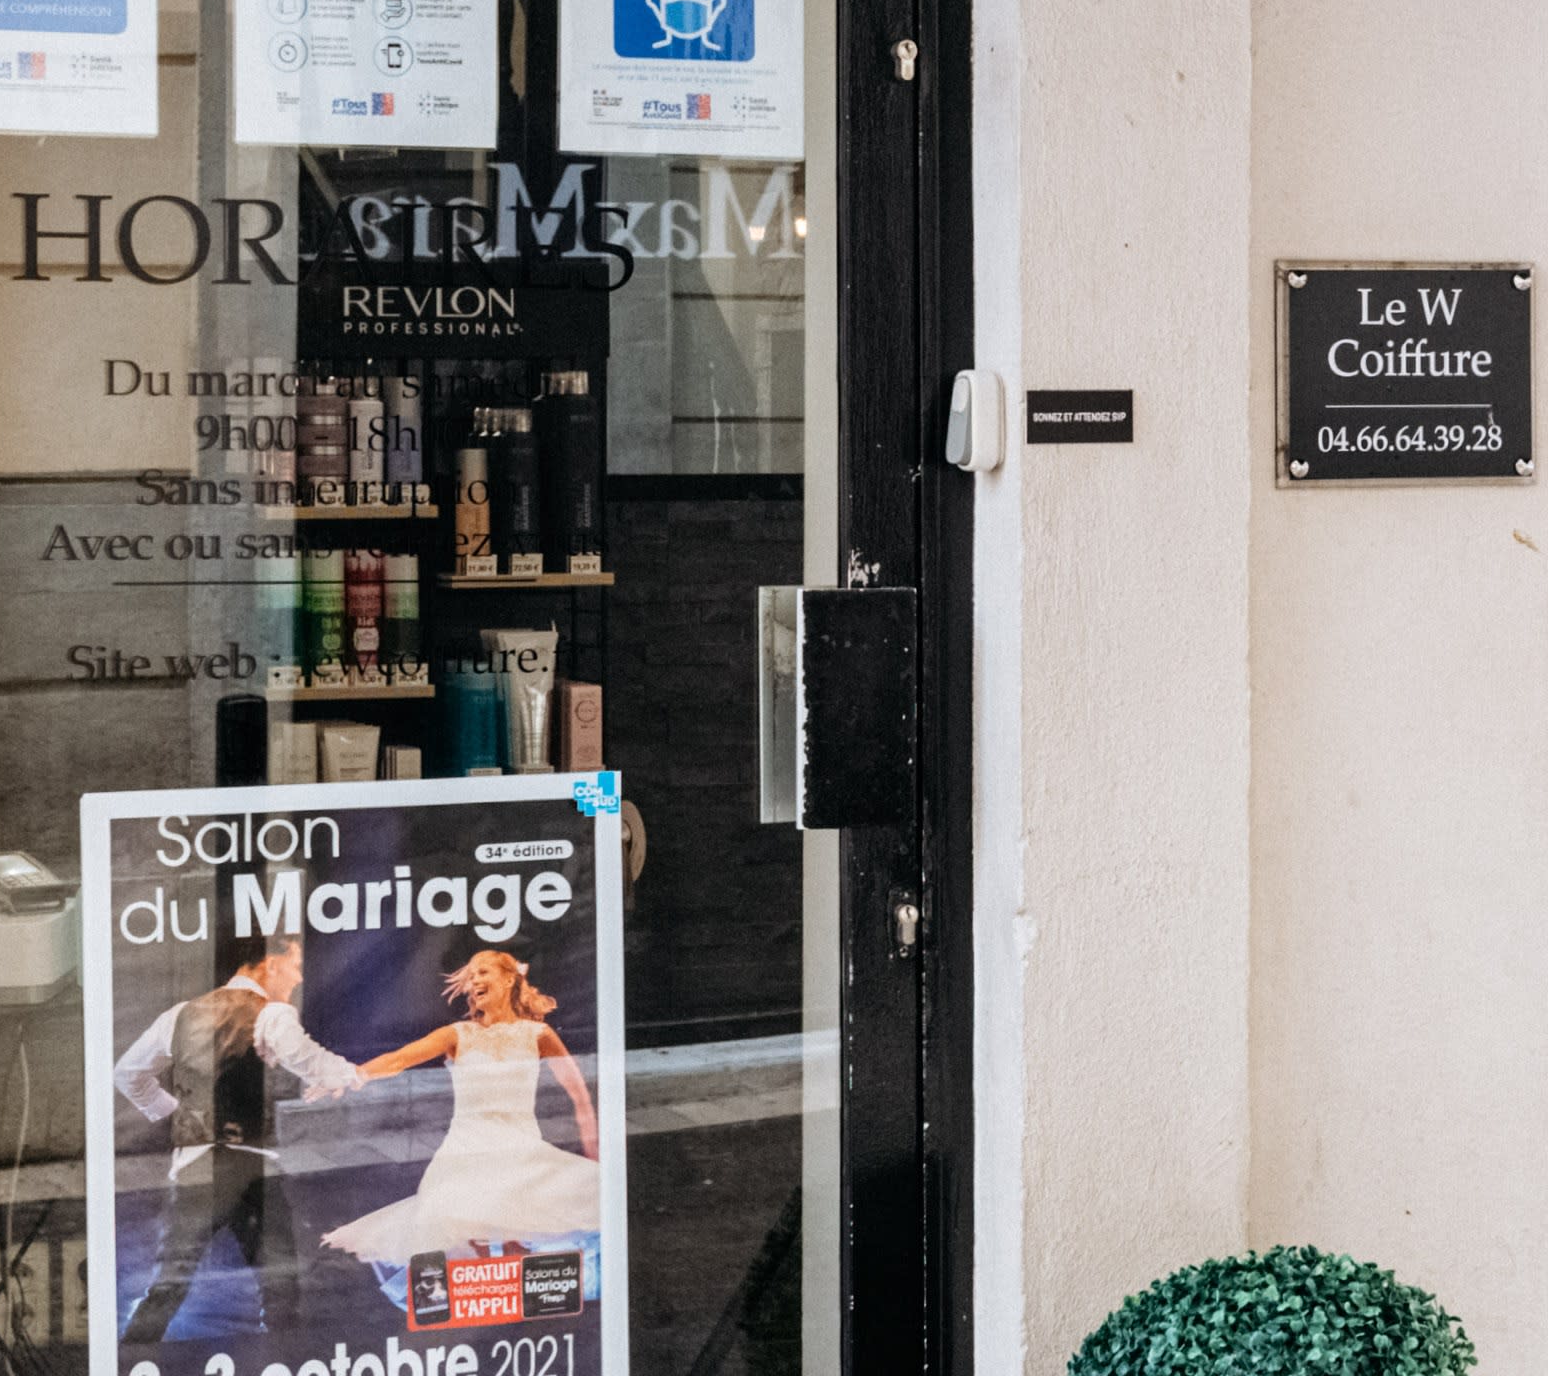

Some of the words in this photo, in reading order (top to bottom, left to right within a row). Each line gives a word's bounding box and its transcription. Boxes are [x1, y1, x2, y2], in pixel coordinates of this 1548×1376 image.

[642, 100, 682, 113] #Tous
[12, 190, 636, 294] HORAIRES
[342, 285, 516, 319] REVLON
[1357, 288, 1406, 326] Le
[1419, 288, 1462, 325] W
[342, 321, 517, 337] PROFESSIONAL
[1327, 339, 1492, 378] Coiffure
[102, 359, 171, 397] Du
[194, 414, 299, 452] 9h00
[351, 413, 465, 454] 18h
[1064, 412, 1073, 423] ET
[1074, 411, 1111, 422] ATTENDEZ
[1317, 425, 1503, 454] 04.66.64.39.28
[137, 469, 241, 507] Sans
[255, 469, 517, 517] inerrupion
[39, 524, 154, 561] Avec
[164, 532, 222, 562] ou
[235, 532, 334, 562] sans
[66, 644, 154, 681] Site
[165, 642, 257, 680] web
[156, 811, 341, 867] Salon
[512, 841, 565, 858] édition
[120, 886, 209, 944] du
[233, 865, 573, 942] Mariage
[452, 1261, 520, 1283] GRATUIT
[524, 1267, 560, 1281] Salons
[562, 1265, 577, 1277] du
[524, 1278, 578, 1294] Mariage
[455, 1296, 517, 1319] L'APPLI
